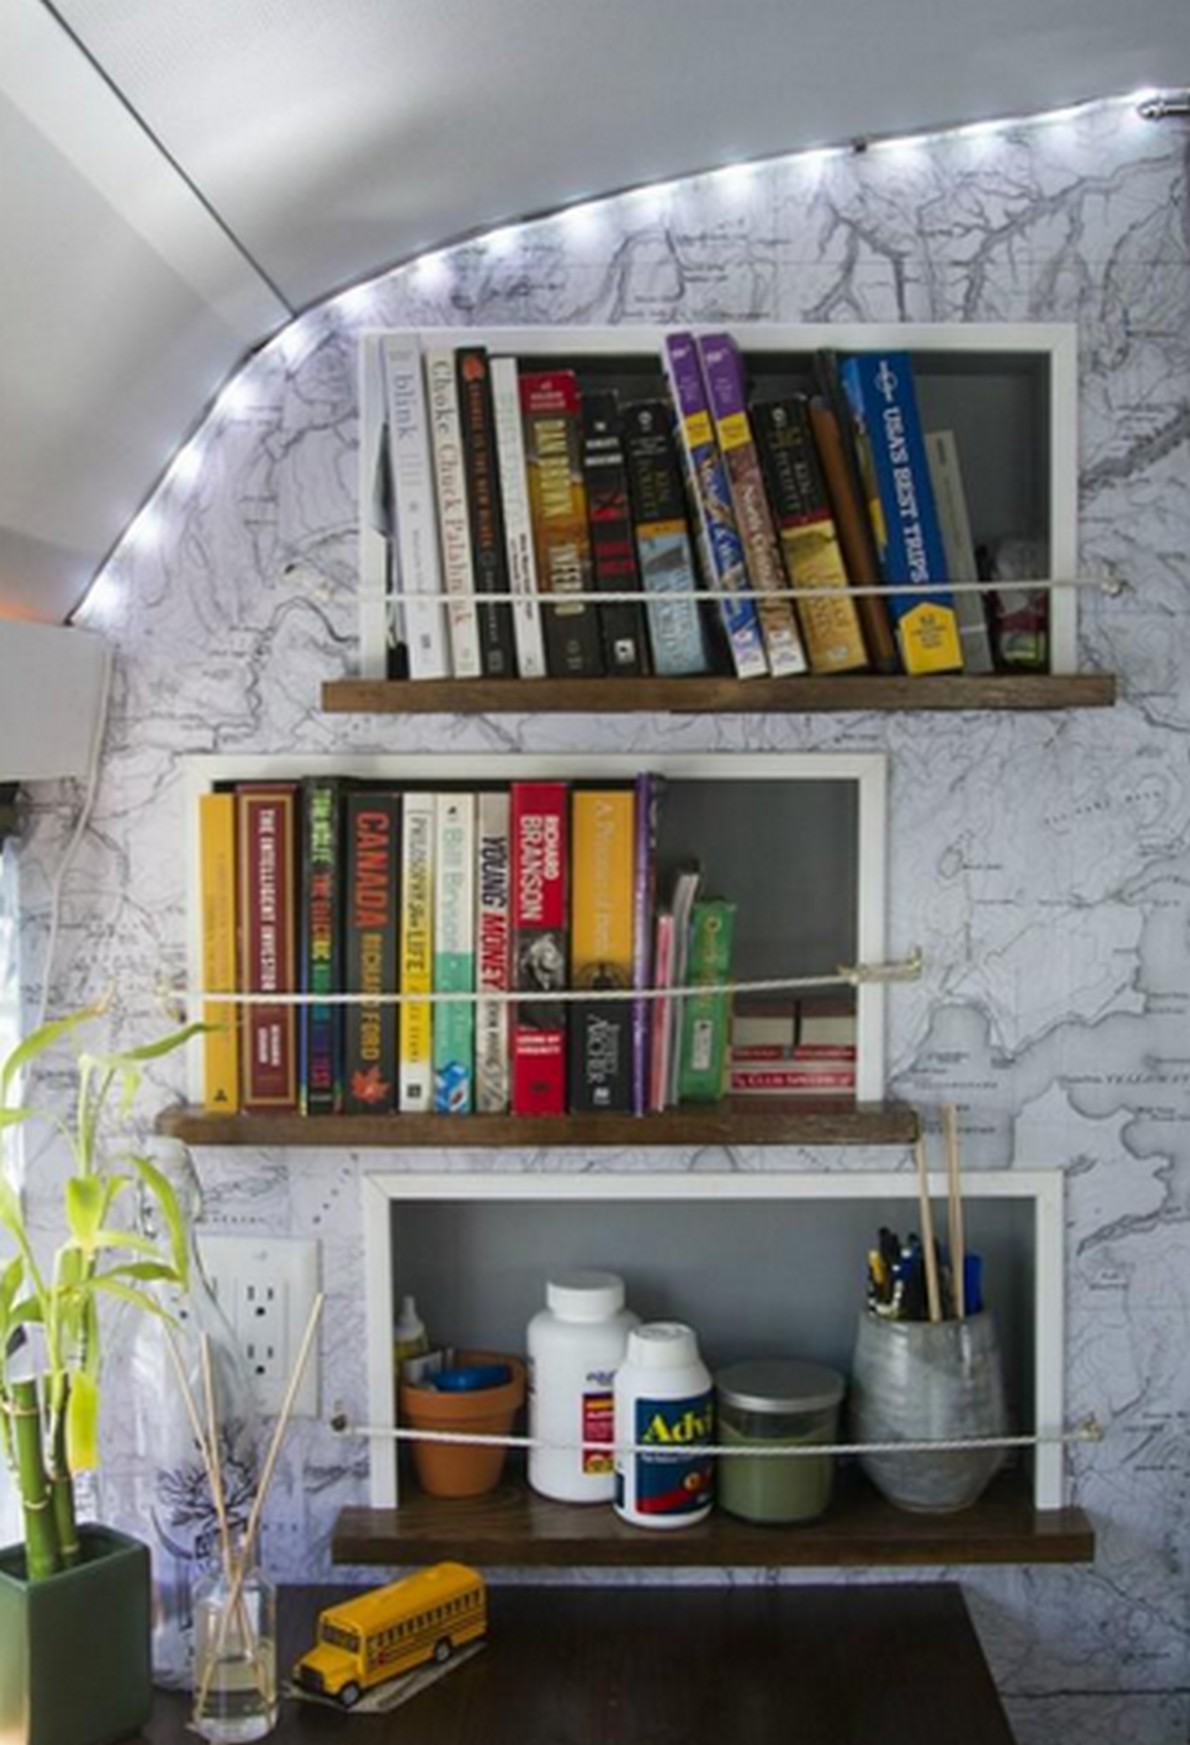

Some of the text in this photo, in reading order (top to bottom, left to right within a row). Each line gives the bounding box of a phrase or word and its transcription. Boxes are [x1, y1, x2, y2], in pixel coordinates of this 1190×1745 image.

[394, 374, 417, 439] blink
[432, 360, 456, 434] Choke
[534, 420, 568, 455] DAN
[537, 456, 571, 518] BROWN
[892, 466, 919, 519] BEST
[438, 444, 472, 625] Chuck Palahnuk
[902, 521, 929, 584] TRIPS
[549, 544, 586, 616] INFERO
[354, 812, 390, 929] CANADA
[408, 817, 425, 901] PHILOSOPHY
[520, 815, 542, 920] BRANSON
[543, 815, 559, 879] RICHARD
[258, 810, 277, 991] THE INTELLIGENT INVESTOR
[439, 828, 462, 950] Bill Bryson
[482, 836, 504, 991] YOUNG MONEY
[406, 931, 426, 971] LIFE
[360, 1013, 382, 1060] FORD
[586, 1014, 606, 1084] ARCHER
